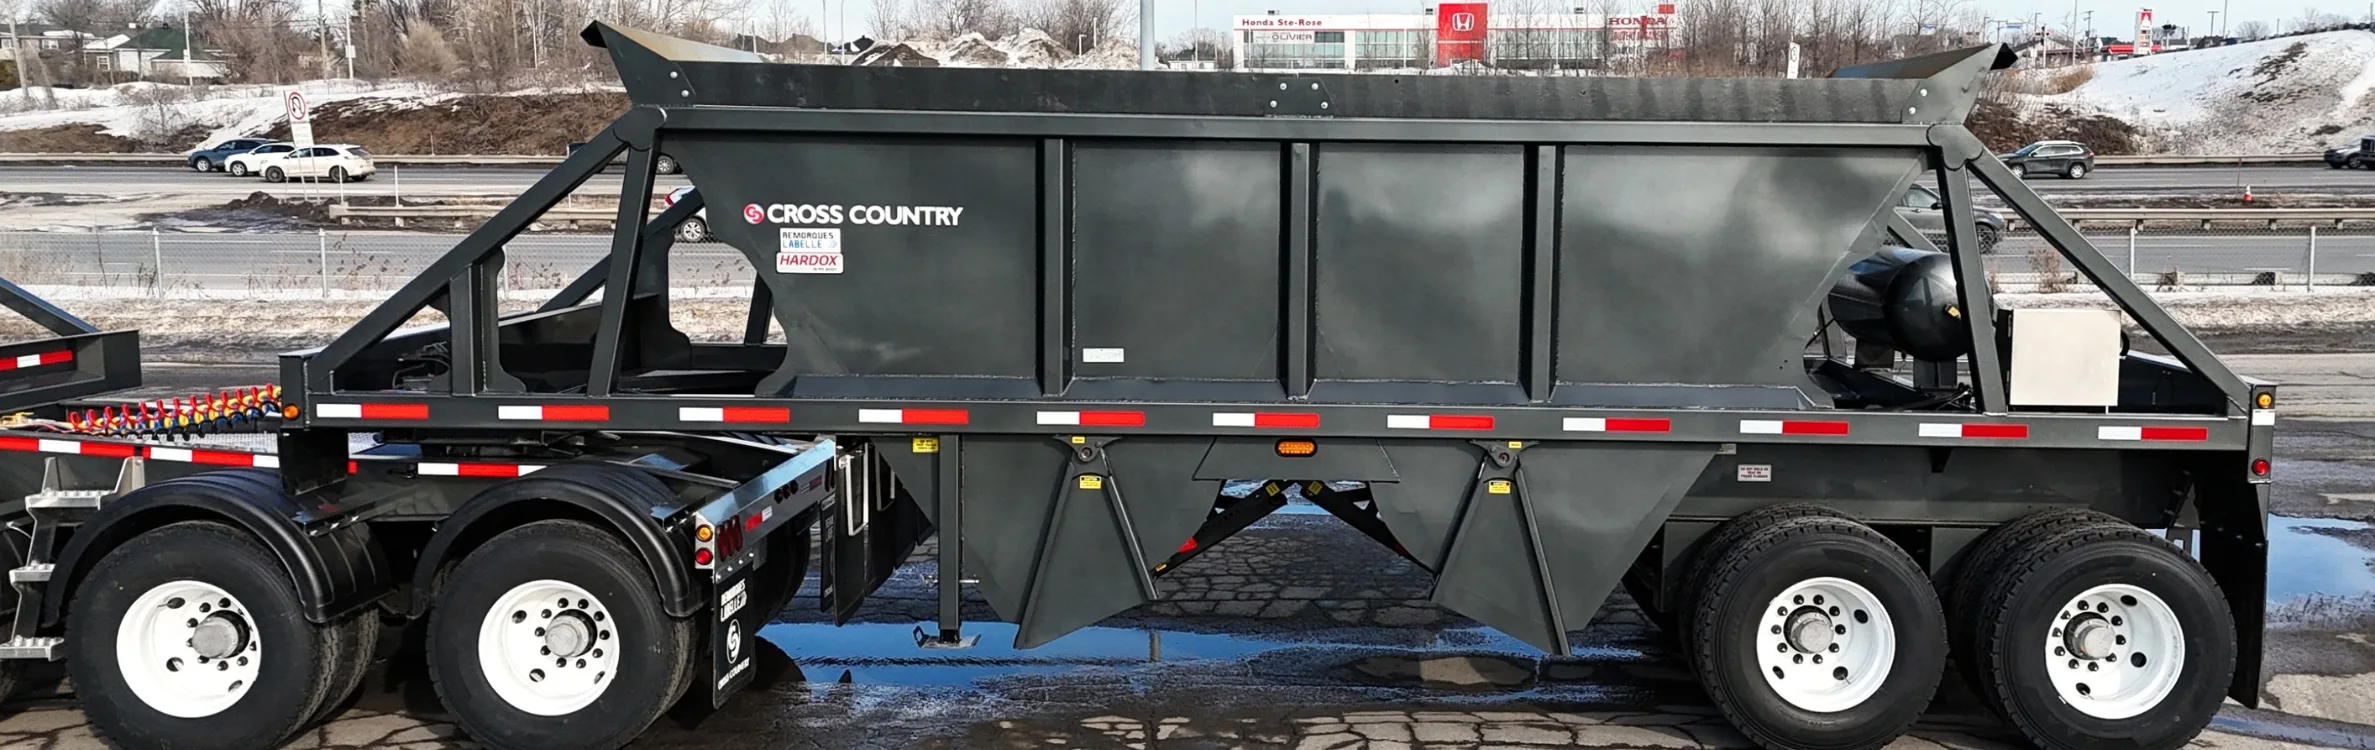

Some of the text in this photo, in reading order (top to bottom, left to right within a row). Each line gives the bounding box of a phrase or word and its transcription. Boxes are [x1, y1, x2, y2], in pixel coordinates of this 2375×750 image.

[767, 203, 964, 226] CROSS COUNTRY
[782, 231, 834, 239] REMORQUES
[782, 240, 822, 248] LABELLE
[779, 255, 838, 266] HARDOX
